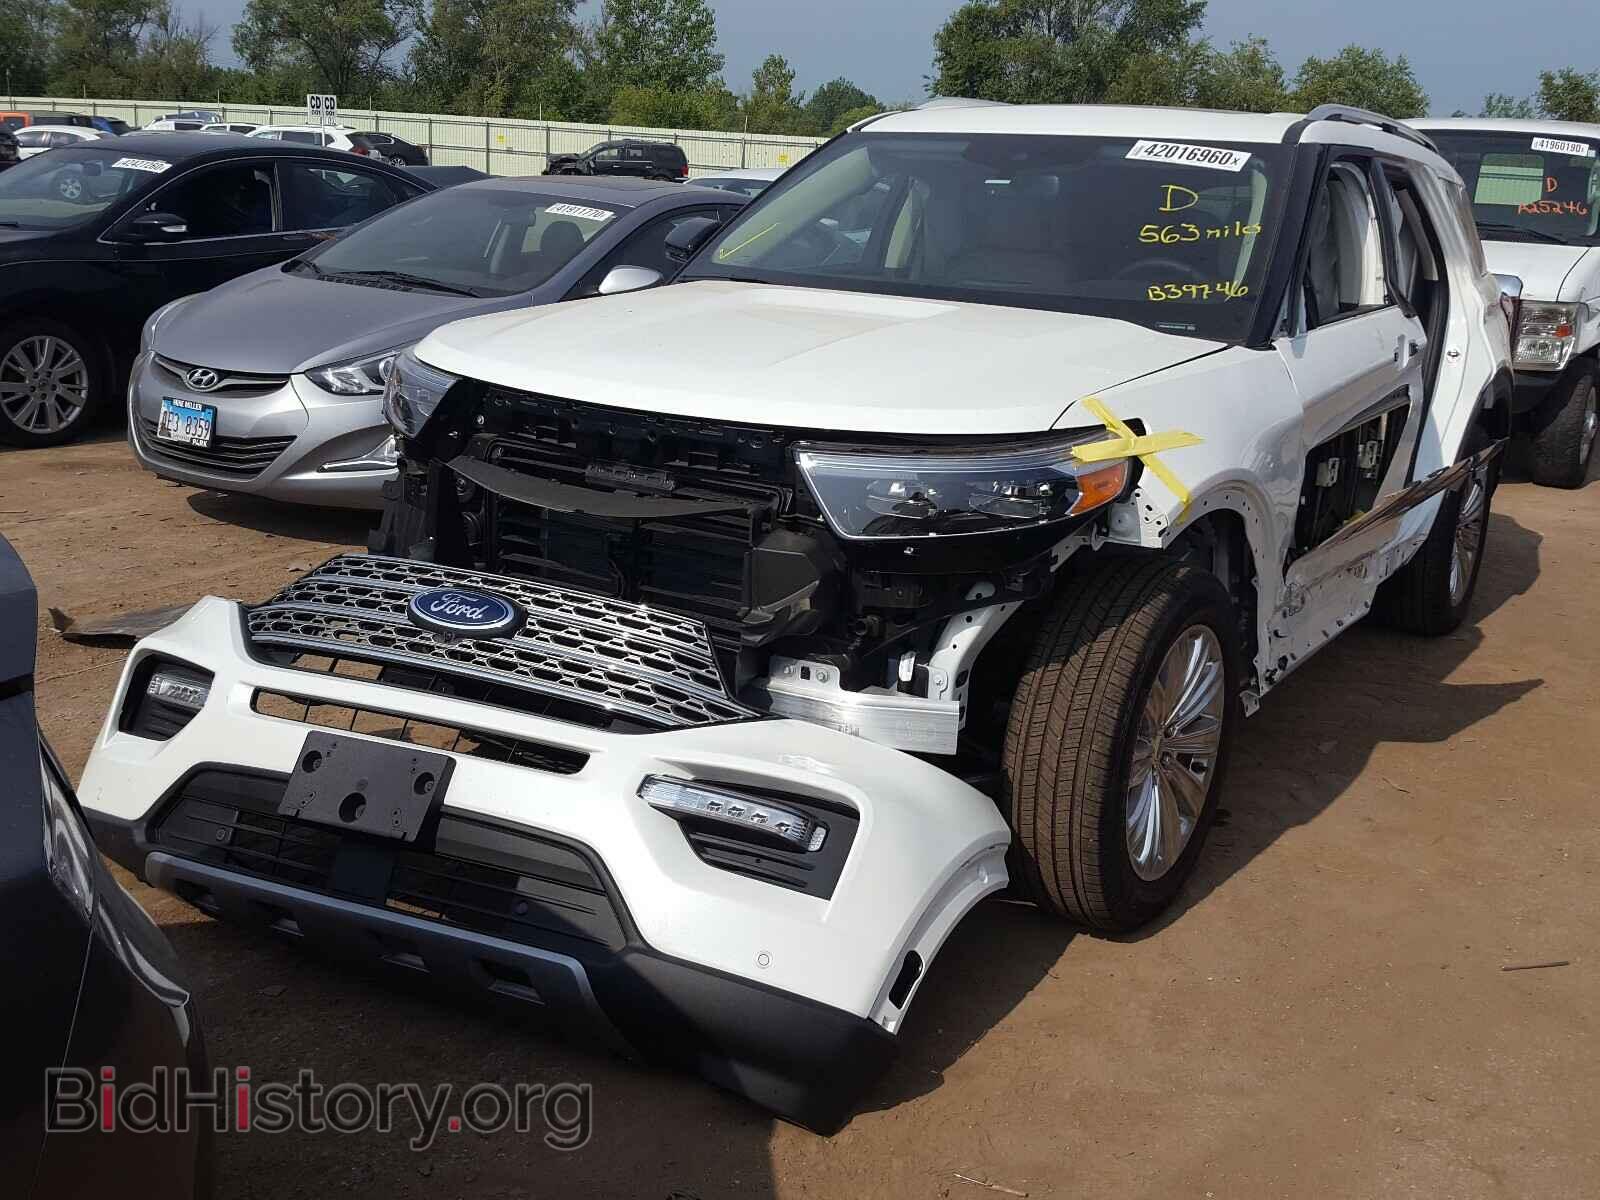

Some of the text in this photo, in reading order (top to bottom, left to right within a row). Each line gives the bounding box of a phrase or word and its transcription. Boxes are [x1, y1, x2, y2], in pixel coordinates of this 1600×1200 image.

[310, 96, 321, 109] CD
[324, 97, 335, 109] CD
[1547, 176, 1558, 192] D
[1159, 184, 1199, 212] D
[1139, 223, 1200, 244] 563
[430, 593, 490, 620] Ford
